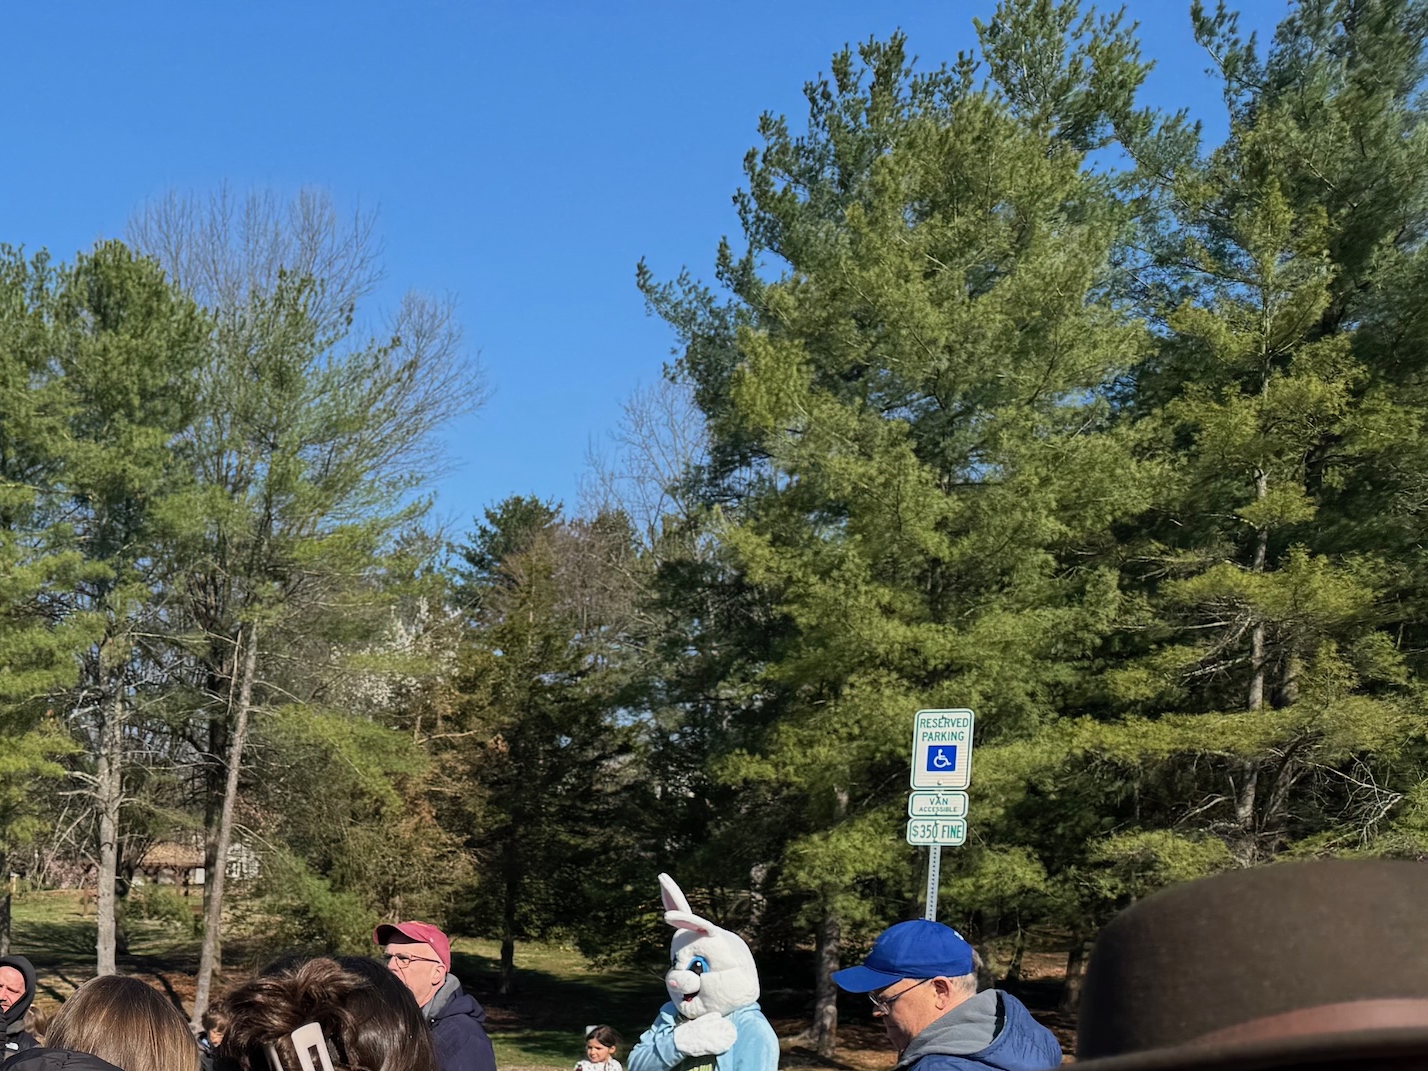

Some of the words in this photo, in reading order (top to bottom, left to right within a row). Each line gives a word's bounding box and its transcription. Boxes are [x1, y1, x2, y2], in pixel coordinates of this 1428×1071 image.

[919, 718, 969, 729] RESERVED
[922, 731, 965, 742] PARKING
[929, 797, 949, 806] VAN
[912, 824, 939, 839] $350
[941, 824, 963, 839] FINE
